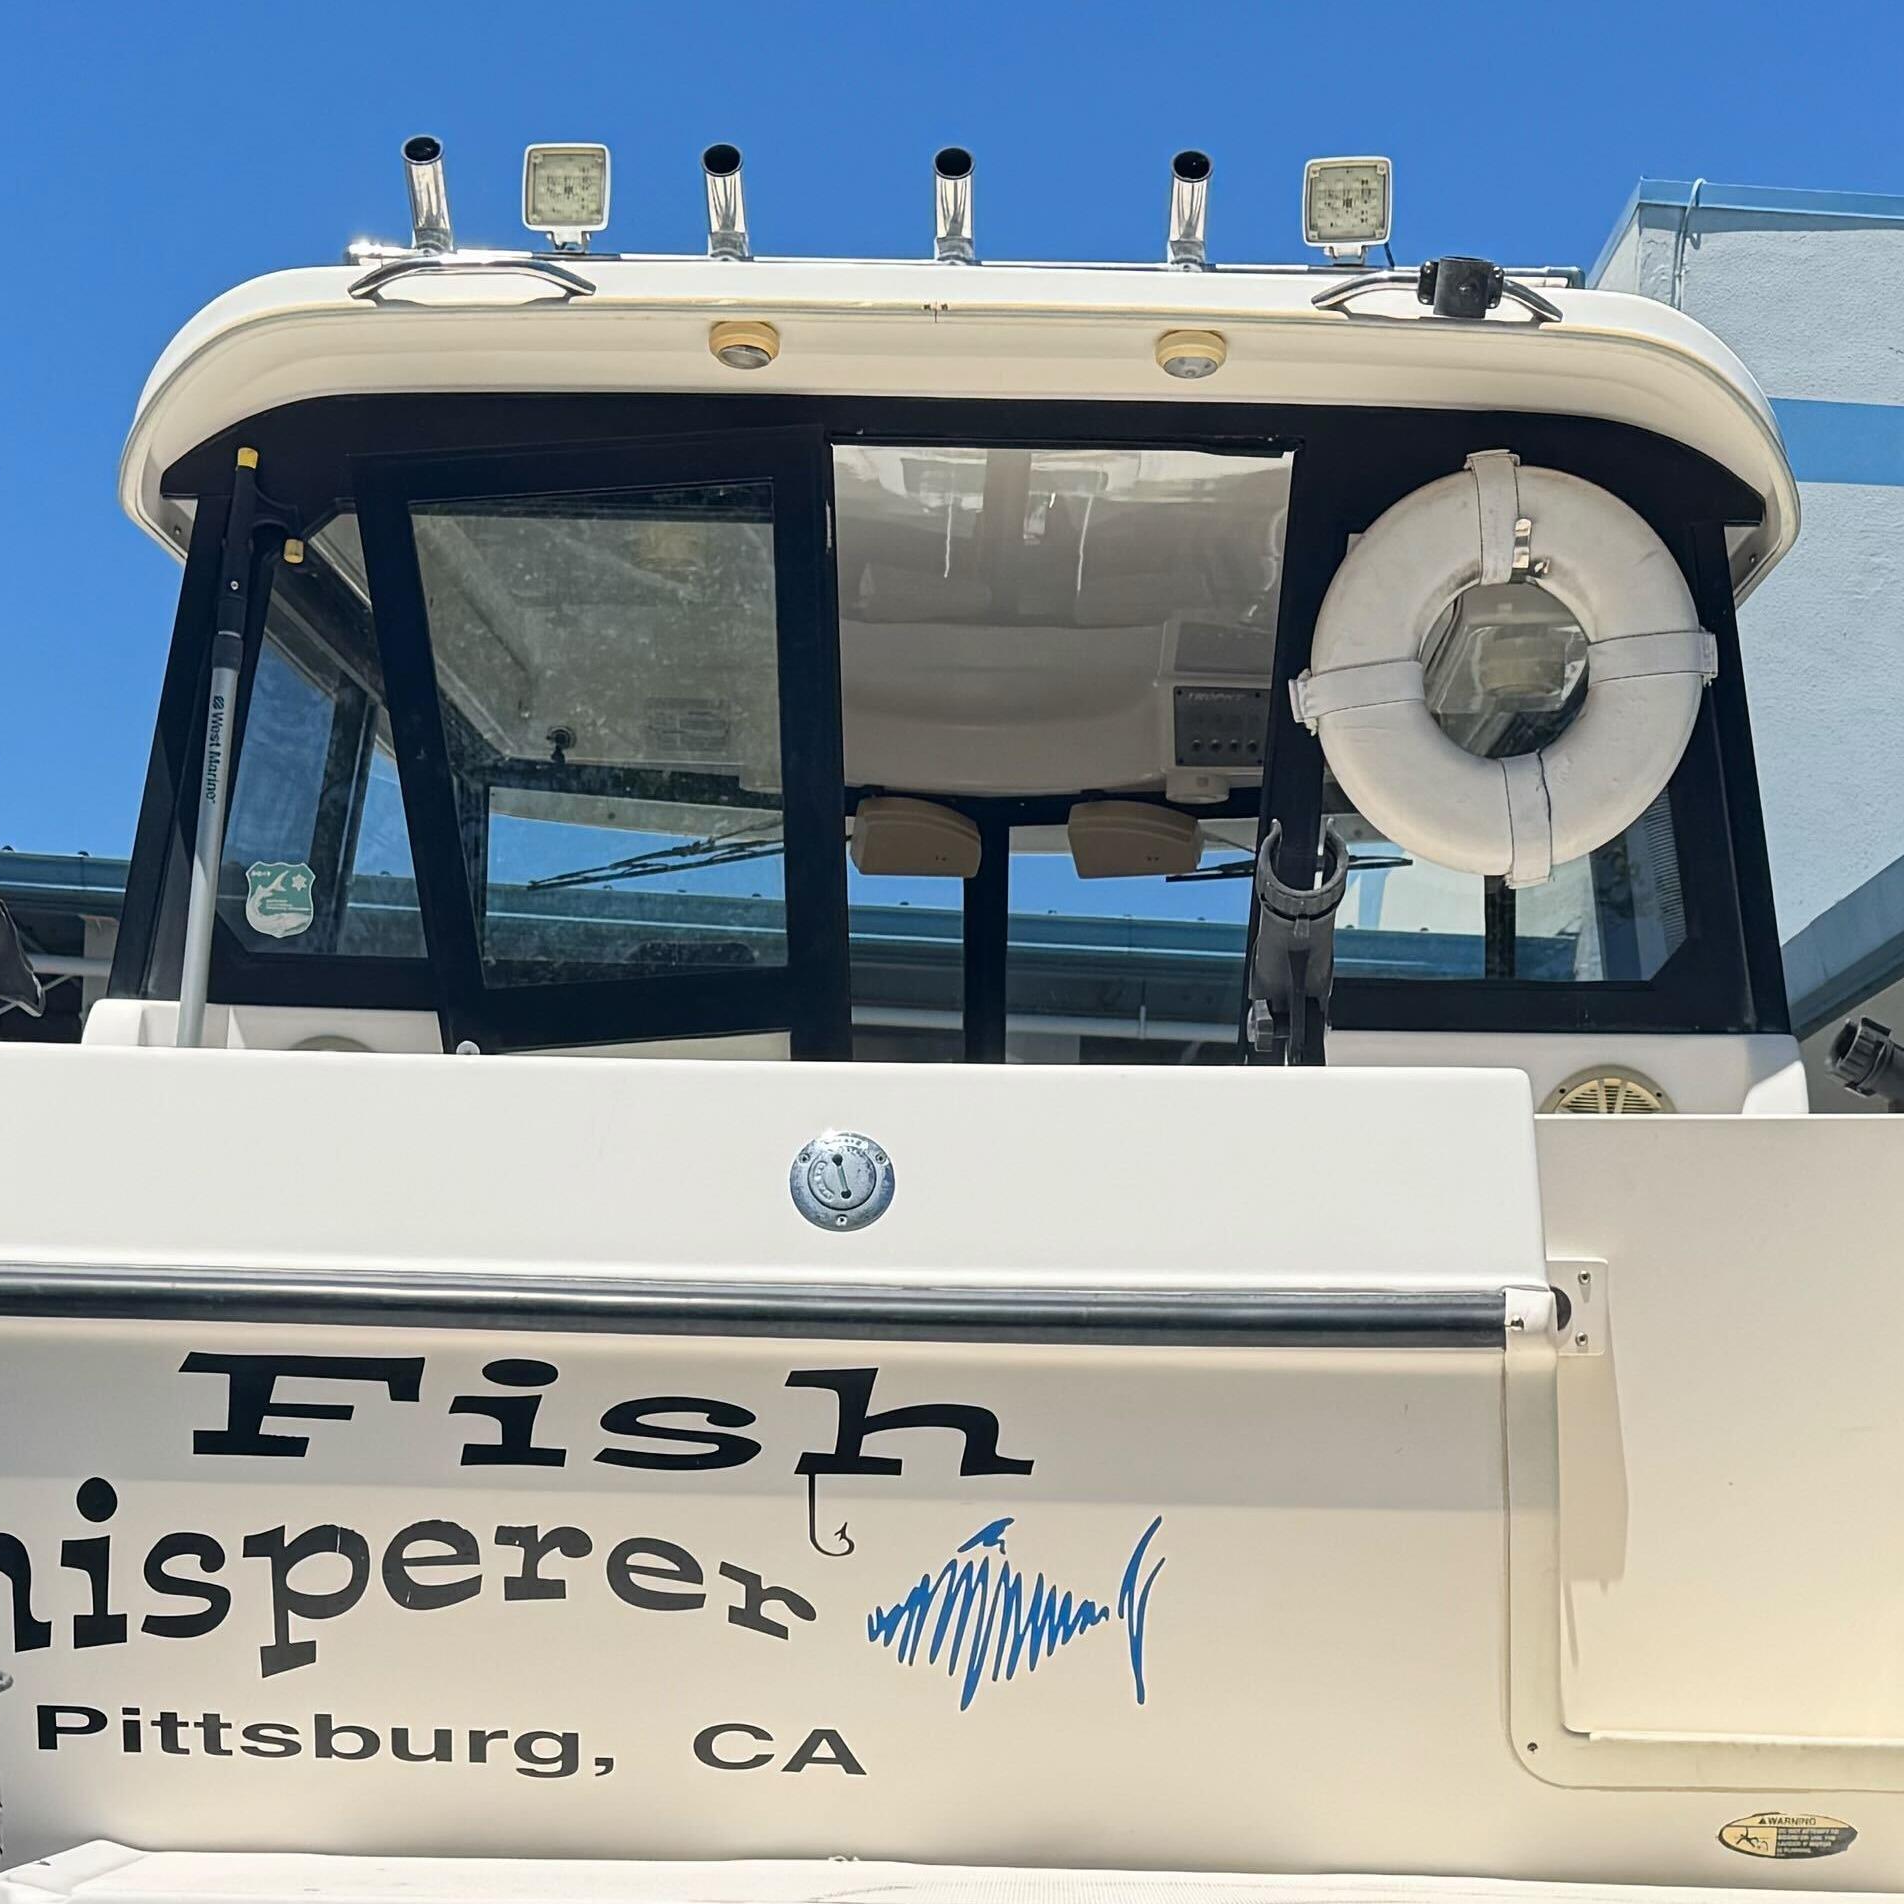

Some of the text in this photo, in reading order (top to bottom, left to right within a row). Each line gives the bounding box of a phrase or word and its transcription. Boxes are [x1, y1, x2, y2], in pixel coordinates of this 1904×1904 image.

[205, 712, 224, 800] West Marine
[178, 1351, 1035, 1477] Fish
[36, 1703, 869, 1778] Pittsburg, CA
[1767, 1817, 1817, 1826] WARNING
